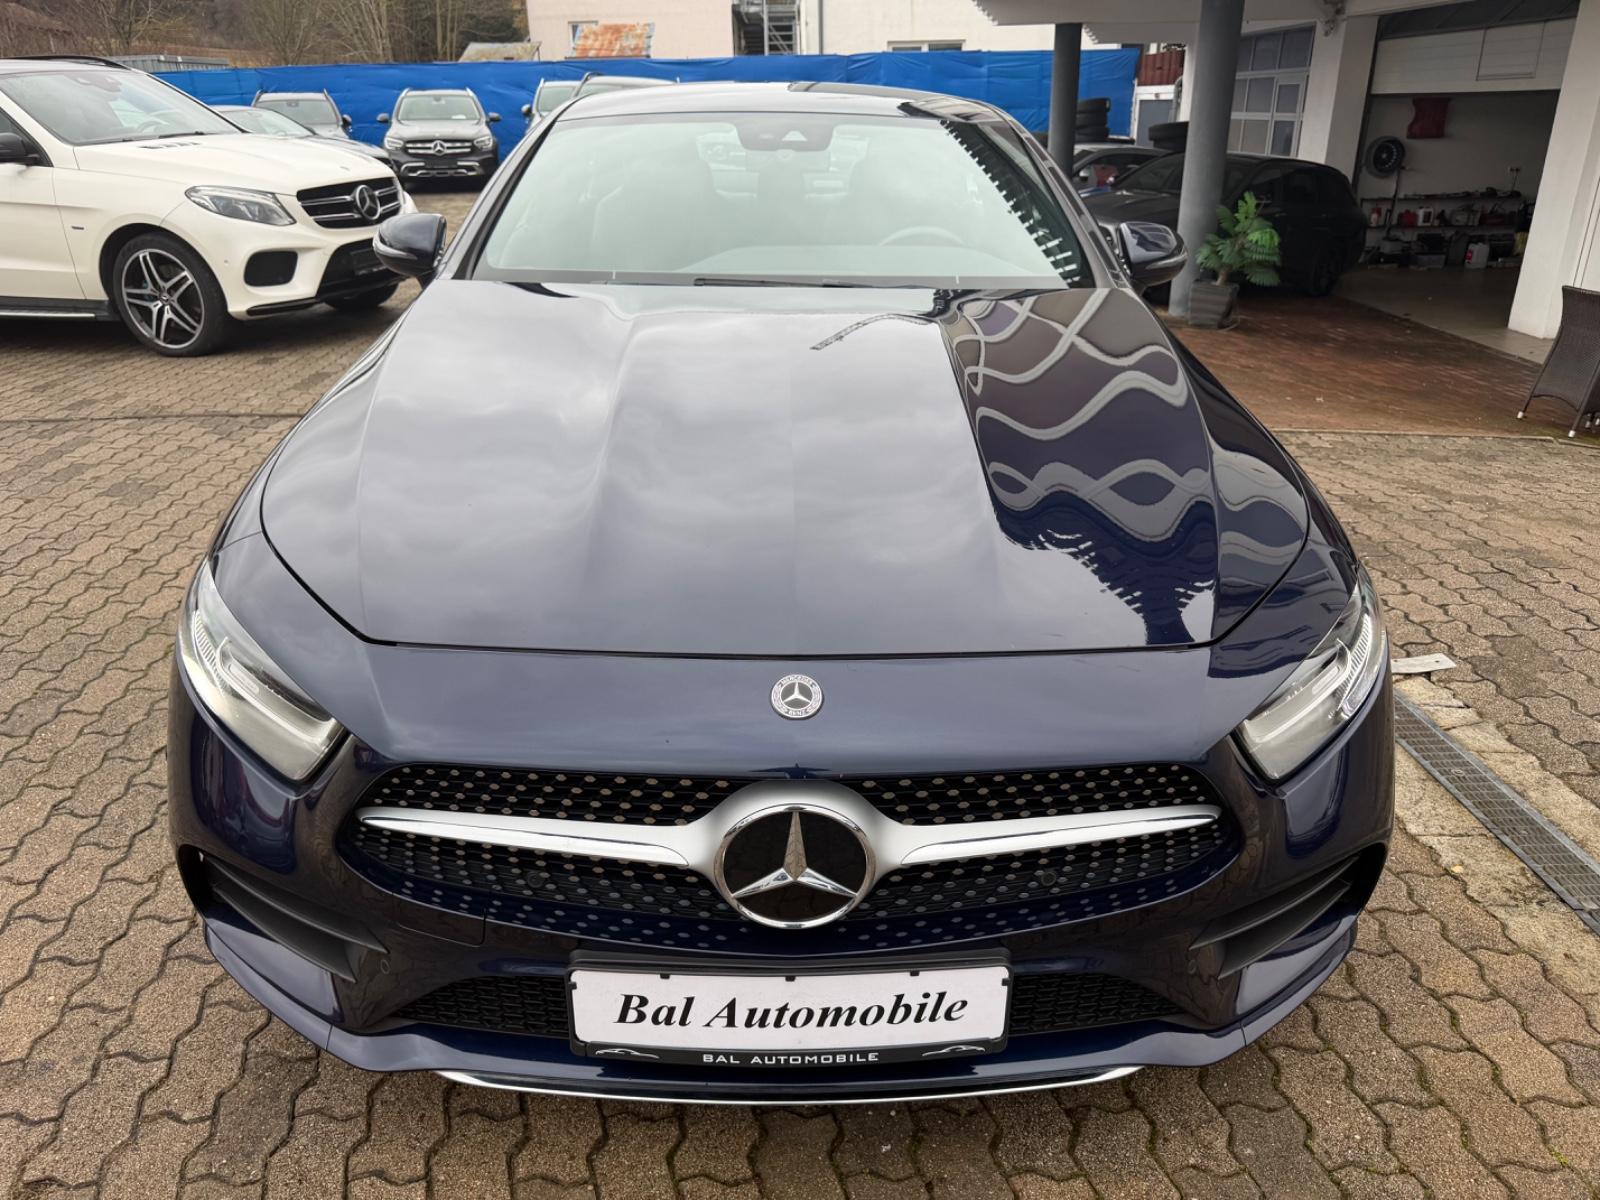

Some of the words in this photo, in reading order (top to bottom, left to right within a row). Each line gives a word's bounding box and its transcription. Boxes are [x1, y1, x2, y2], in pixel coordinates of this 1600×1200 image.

[613, 993, 695, 1027] Bal
[703, 991, 968, 1029] Automobile
[703, 1053, 740, 1064] BAL
[750, 1052, 880, 1065] AUTOMOBILE
